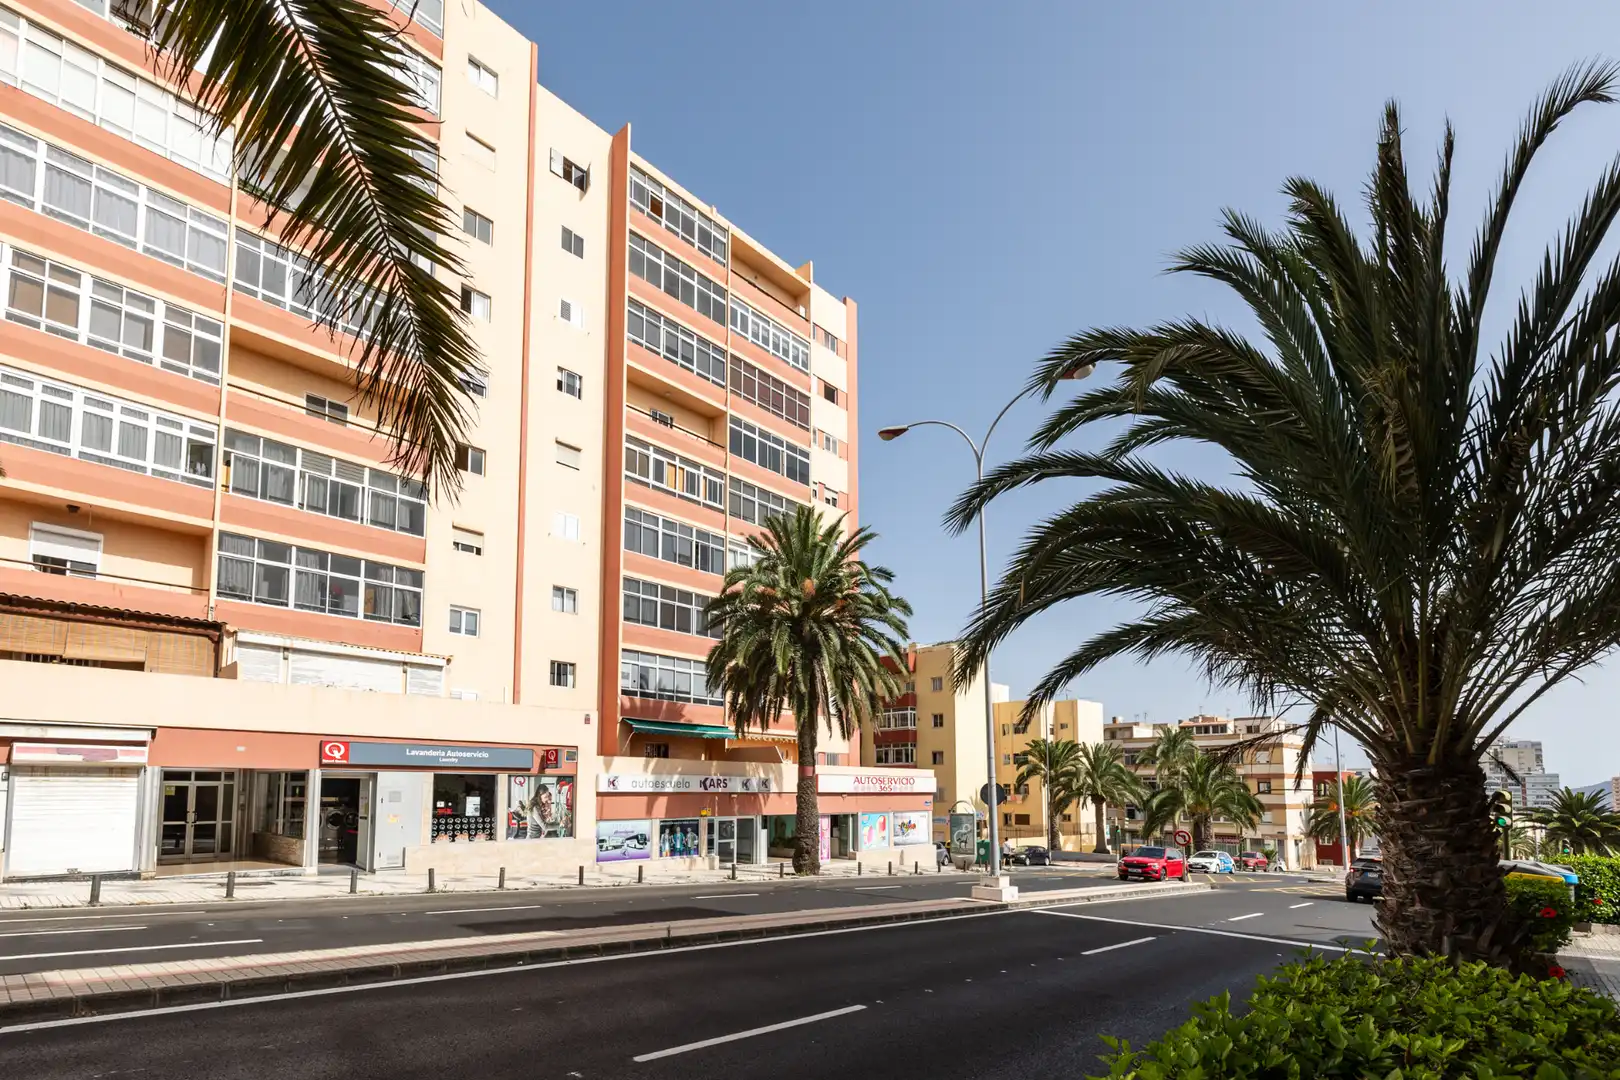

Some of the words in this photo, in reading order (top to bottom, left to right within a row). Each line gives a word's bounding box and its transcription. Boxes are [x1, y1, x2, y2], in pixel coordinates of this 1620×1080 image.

[446, 750, 489, 758] Autoservicio
[631, 778, 690, 789] autoescuela
[699, 777, 728, 790] KARS
[853, 776, 915, 785] AUTOSERVICIO
